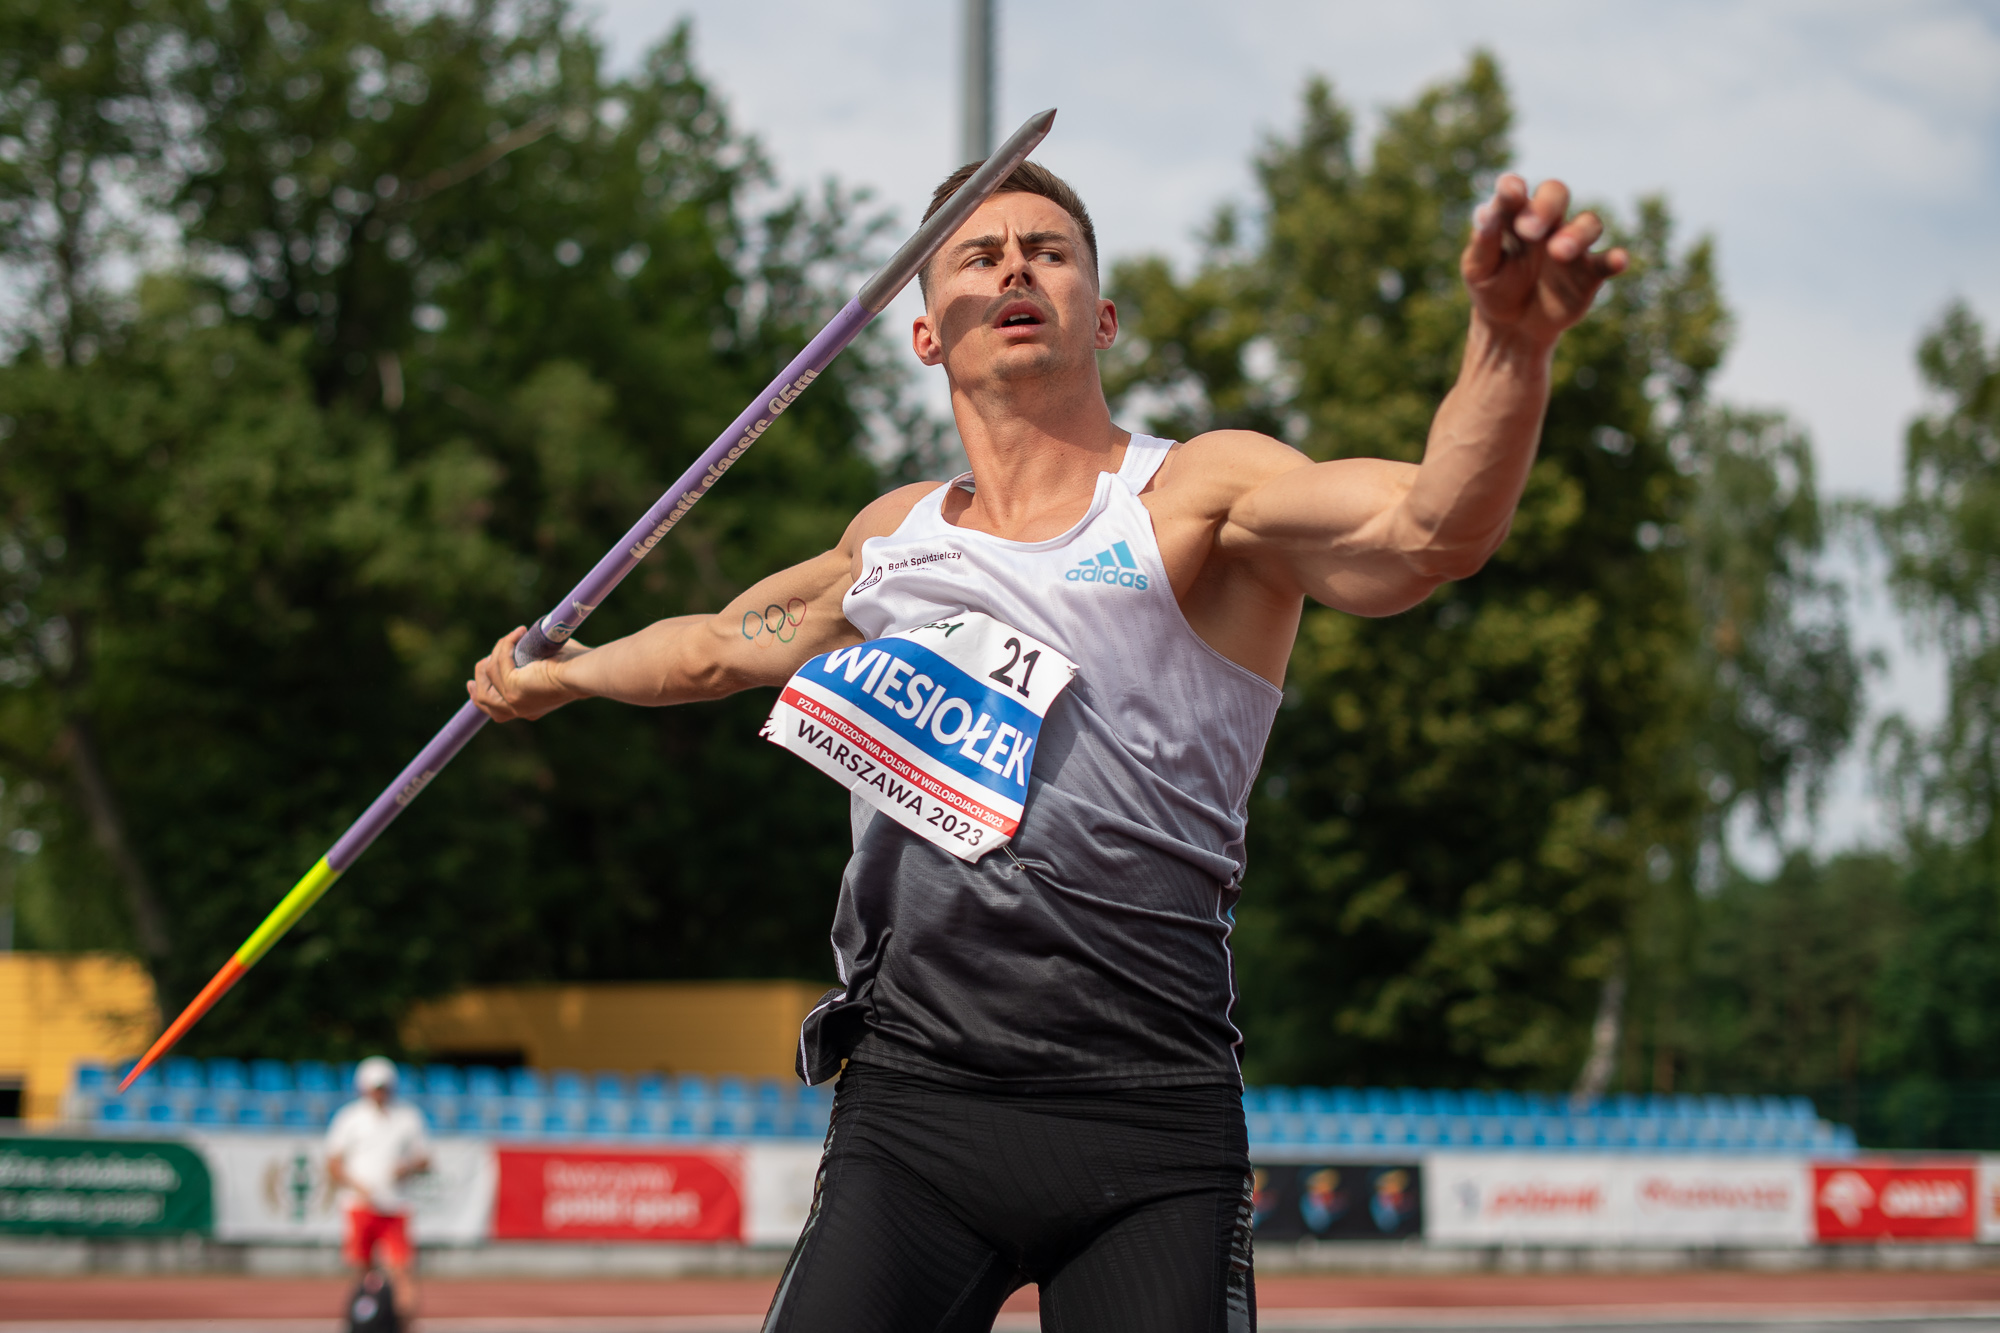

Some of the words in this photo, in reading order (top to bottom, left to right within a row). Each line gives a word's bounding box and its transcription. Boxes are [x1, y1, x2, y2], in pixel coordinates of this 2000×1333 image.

[888, 558, 909, 571] Bank
[910, 550, 962, 567] Spółdzielczy
[1065, 564, 1149, 591] adidas
[988, 637, 1042, 698] 21
[796, 697, 820, 717] PZLA
[820, 710, 880, 757] MISTRZOSTWA
[879, 750, 910, 776] POLSKI
[909, 769, 922, 783] W
[920, 776, 984, 818] WIELOBOJACH
[981, 811, 1005, 828] 2023
[823, 646, 1033, 787] WIESIOŁEK
[798, 718, 923, 816] WARSZAWA
[925, 806, 984, 847] 2023
